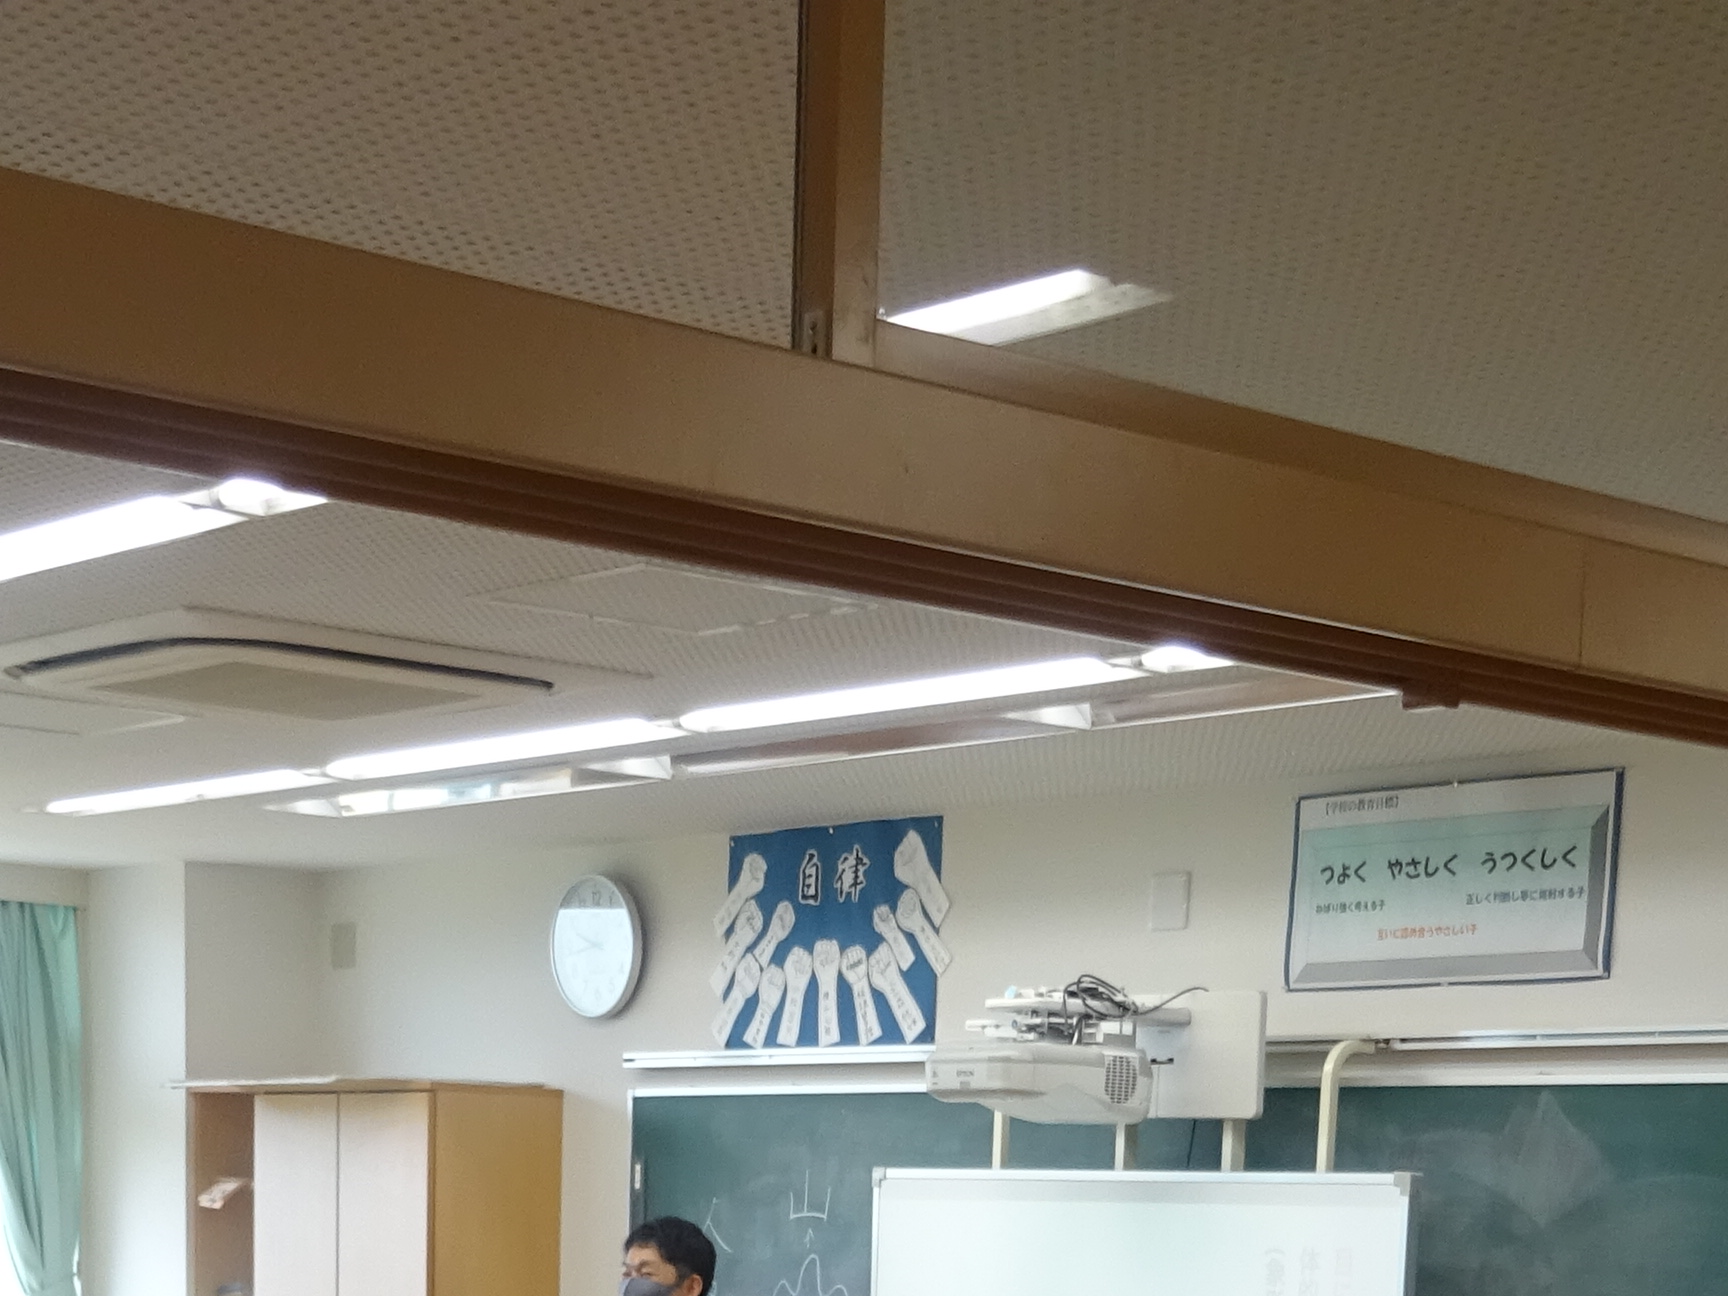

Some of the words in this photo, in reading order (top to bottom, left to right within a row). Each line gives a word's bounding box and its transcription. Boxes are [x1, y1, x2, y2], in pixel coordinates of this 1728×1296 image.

[801, 848, 869, 903] 自律
[1320, 860, 1368, 885] つよく
[1387, 854, 1459, 881] やさしく
[1480, 845, 1578, 875] うつくしく
[789, 1169, 832, 1221] 山
